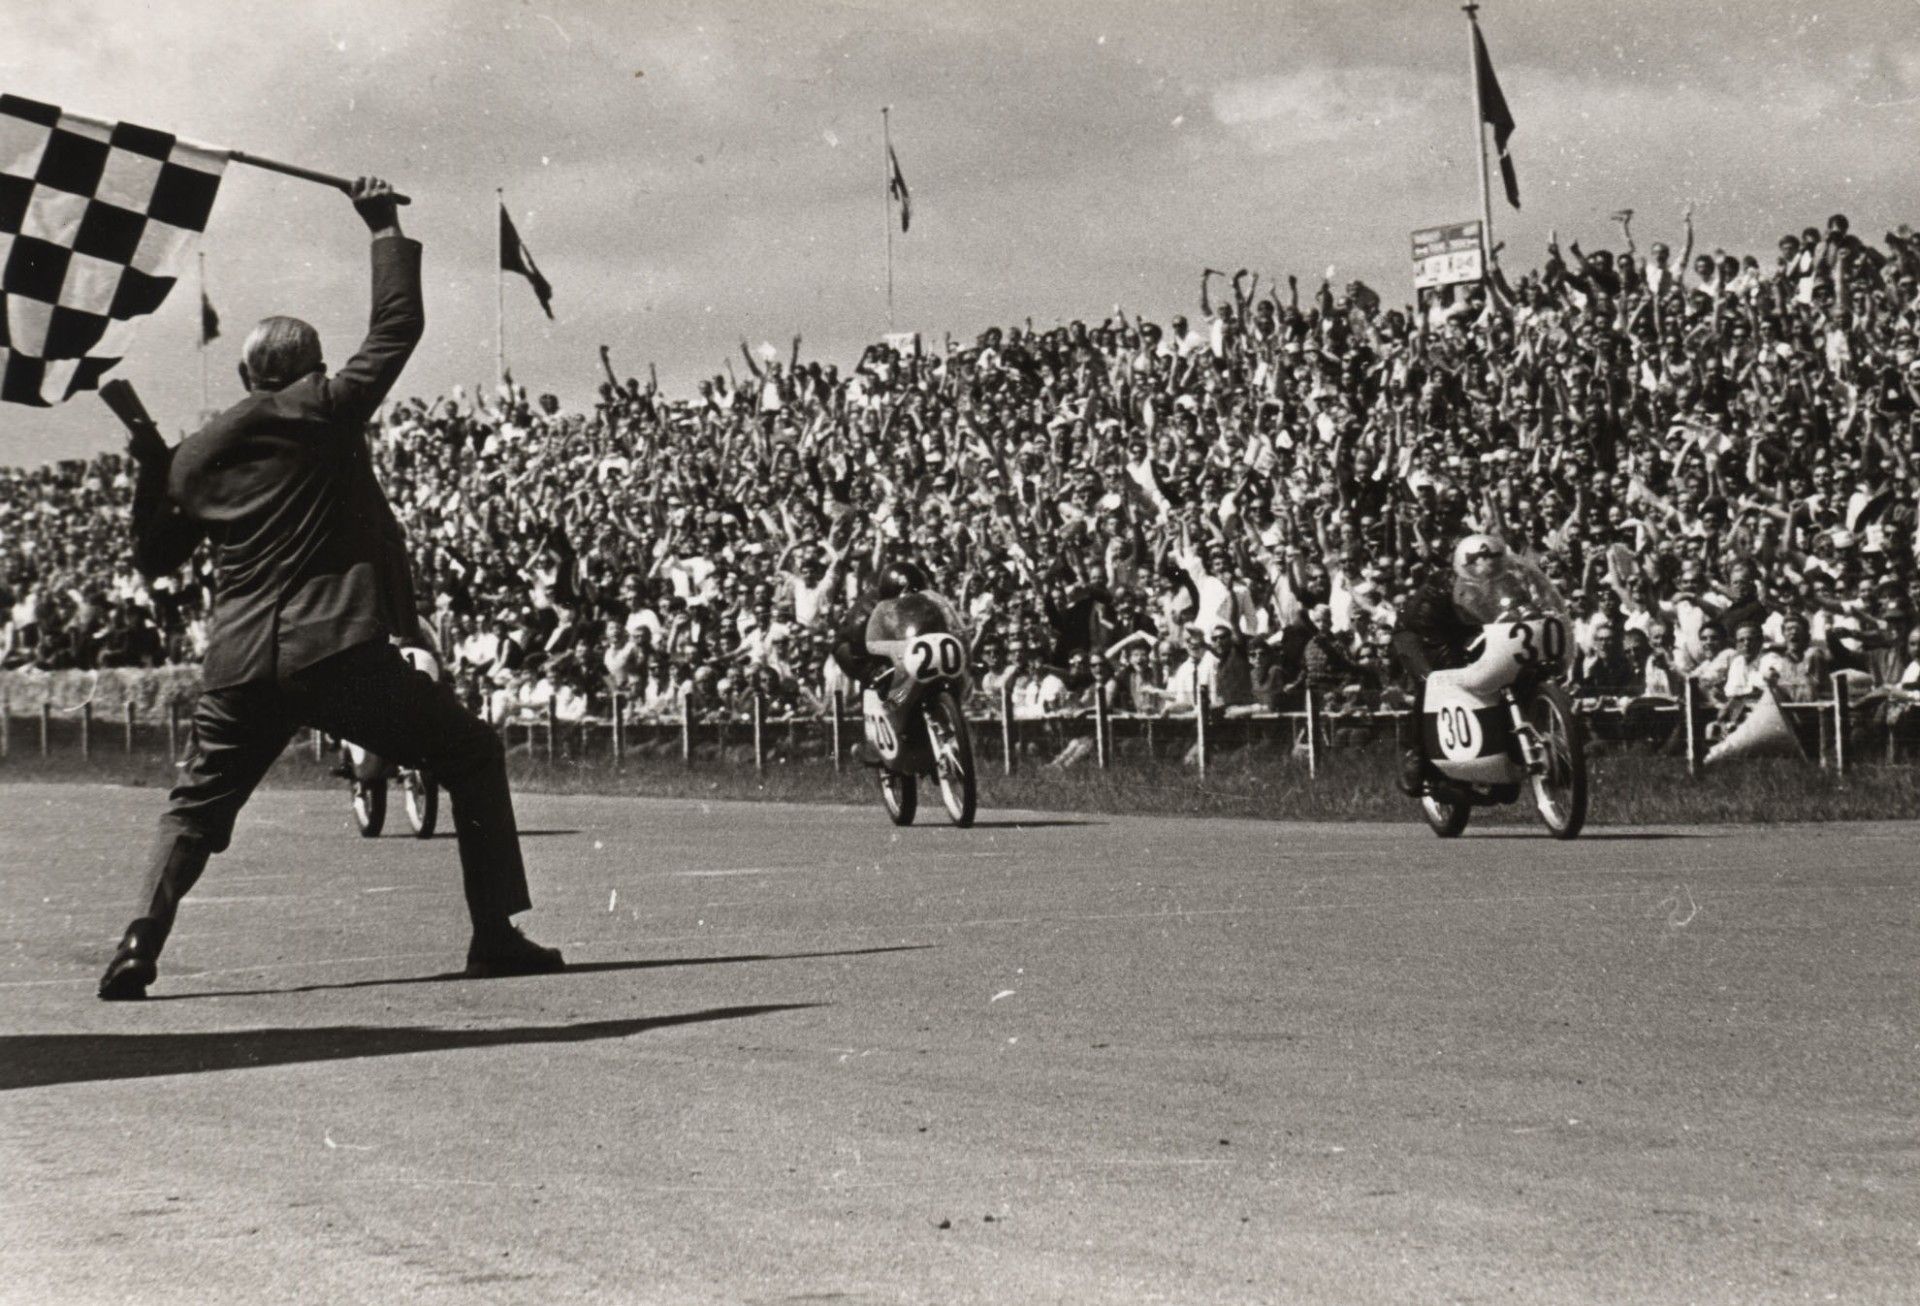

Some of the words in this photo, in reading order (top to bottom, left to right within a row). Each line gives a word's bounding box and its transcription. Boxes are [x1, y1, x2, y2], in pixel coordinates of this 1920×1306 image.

[912, 638, 962, 680] 20
[1509, 617, 1566, 666] 30
[1441, 706, 1472, 751] 30
